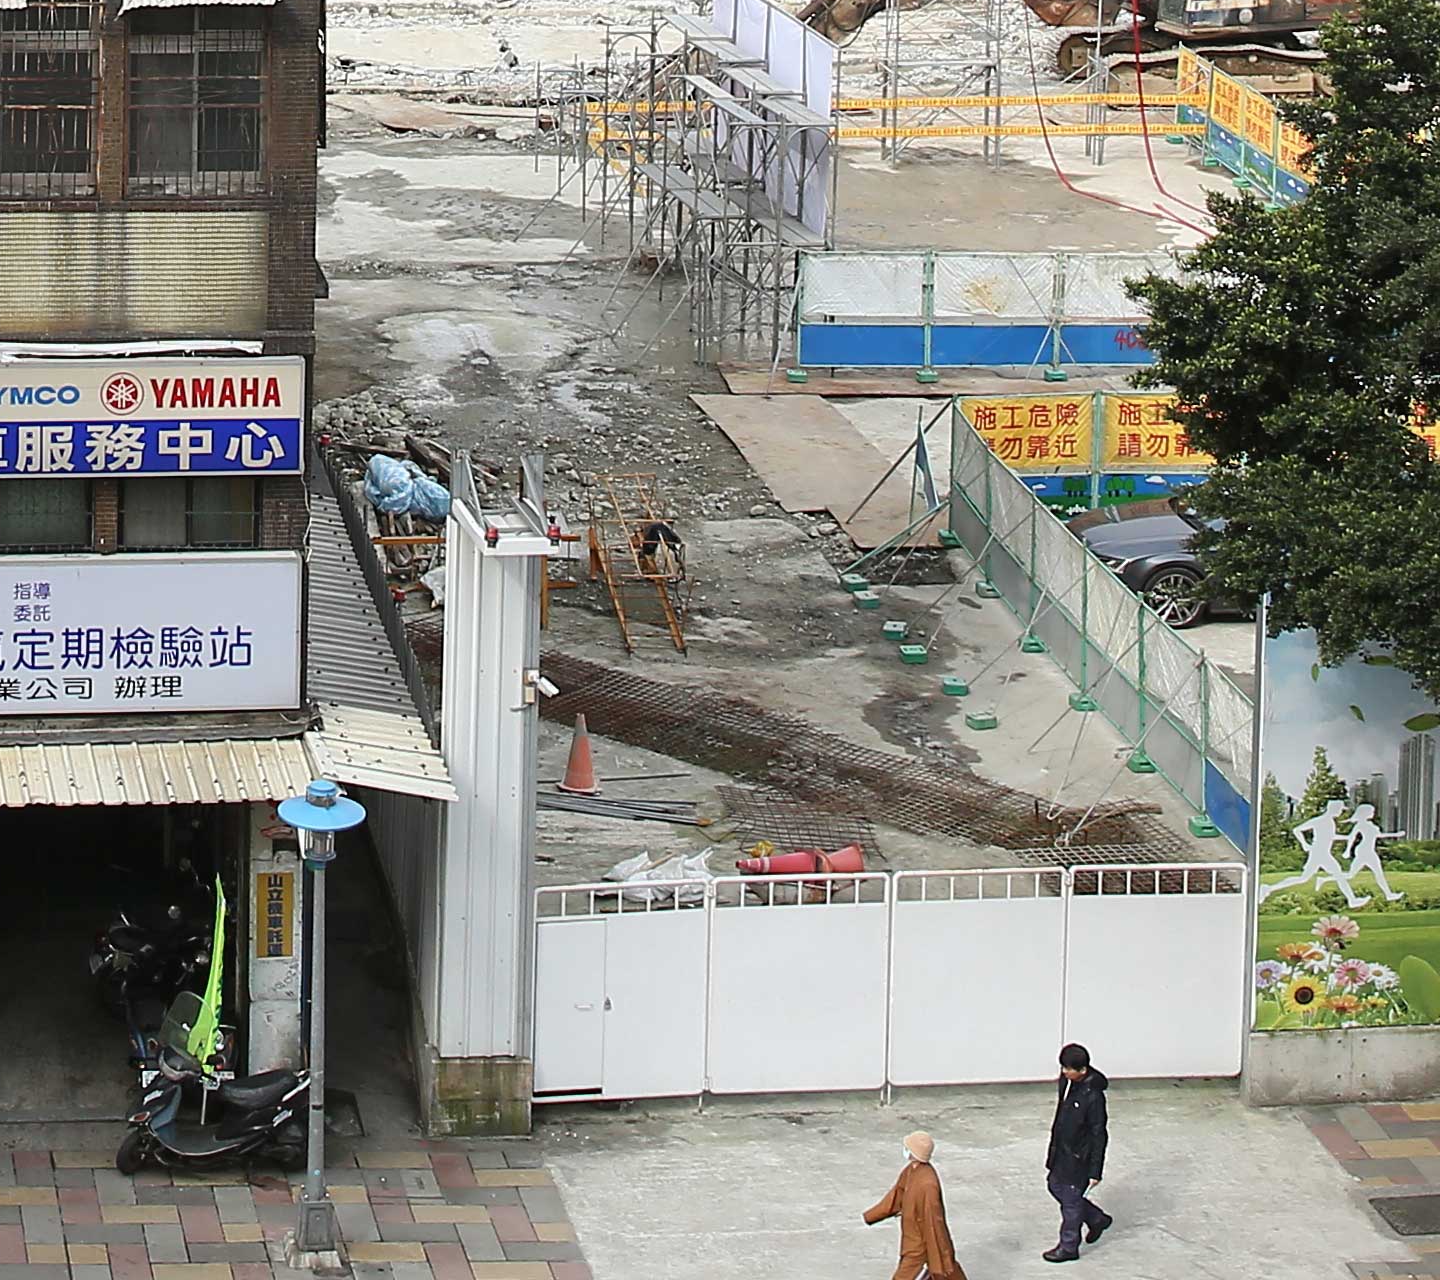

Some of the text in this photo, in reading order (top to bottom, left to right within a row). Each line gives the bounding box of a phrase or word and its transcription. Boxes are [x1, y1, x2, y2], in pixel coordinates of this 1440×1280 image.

[150, 376, 282, 409] YAMAHA
[974, 403, 1079, 431] 施工危險
[13, 582, 51, 602] 指導
[13, 604, 51, 622] 委託
[114, 675, 184, 699] 辦理
